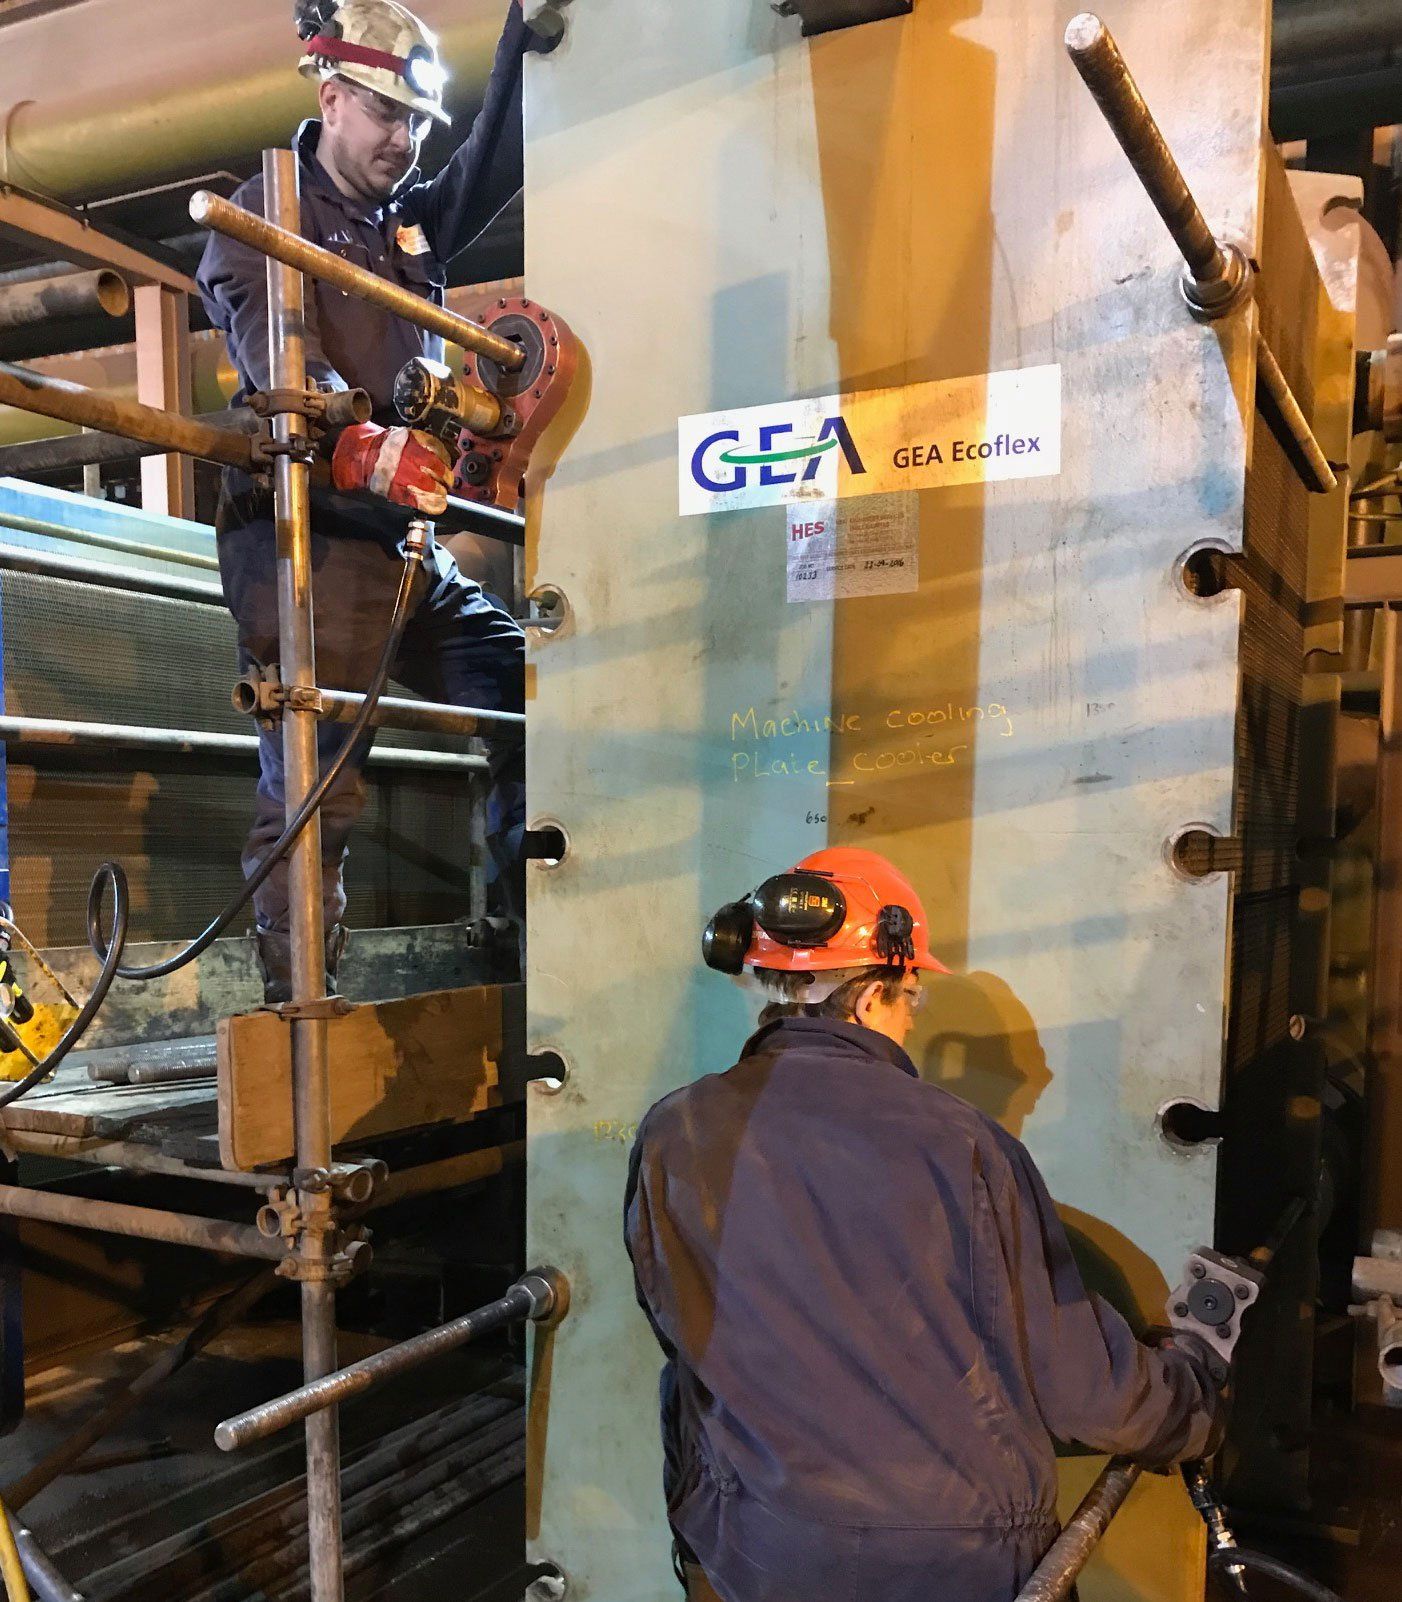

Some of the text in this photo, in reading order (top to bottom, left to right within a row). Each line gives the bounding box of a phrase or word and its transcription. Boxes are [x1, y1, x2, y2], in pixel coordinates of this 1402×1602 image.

[691, 416, 867, 492] GEA
[893, 434, 1041, 469] GEA Ecoflex
[791, 521, 825, 541] HES
